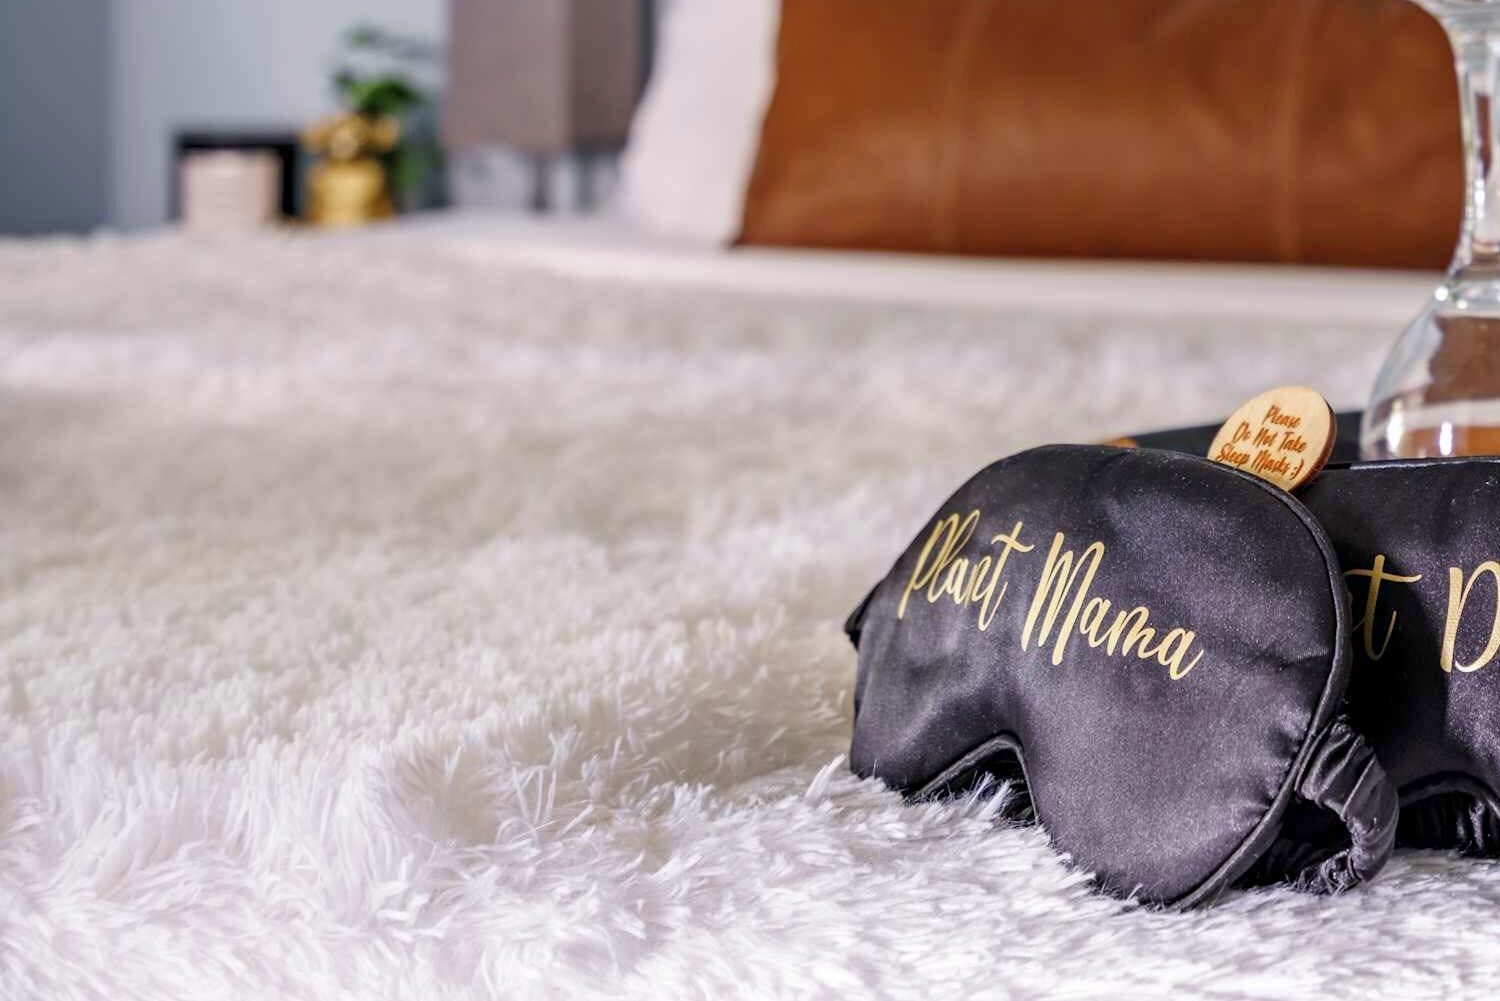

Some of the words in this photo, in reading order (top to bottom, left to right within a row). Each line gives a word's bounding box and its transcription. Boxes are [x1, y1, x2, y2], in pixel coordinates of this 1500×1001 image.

[1262, 404, 1301, 429] Please
[1232, 420, 1252, 443] Do
[1253, 427, 1278, 448] Not
[1278, 431, 1307, 453] Take
[1215, 442, 1249, 467] Sleep
[897, 509, 1035, 632] Plant
[1020, 531, 1204, 681] Mama
